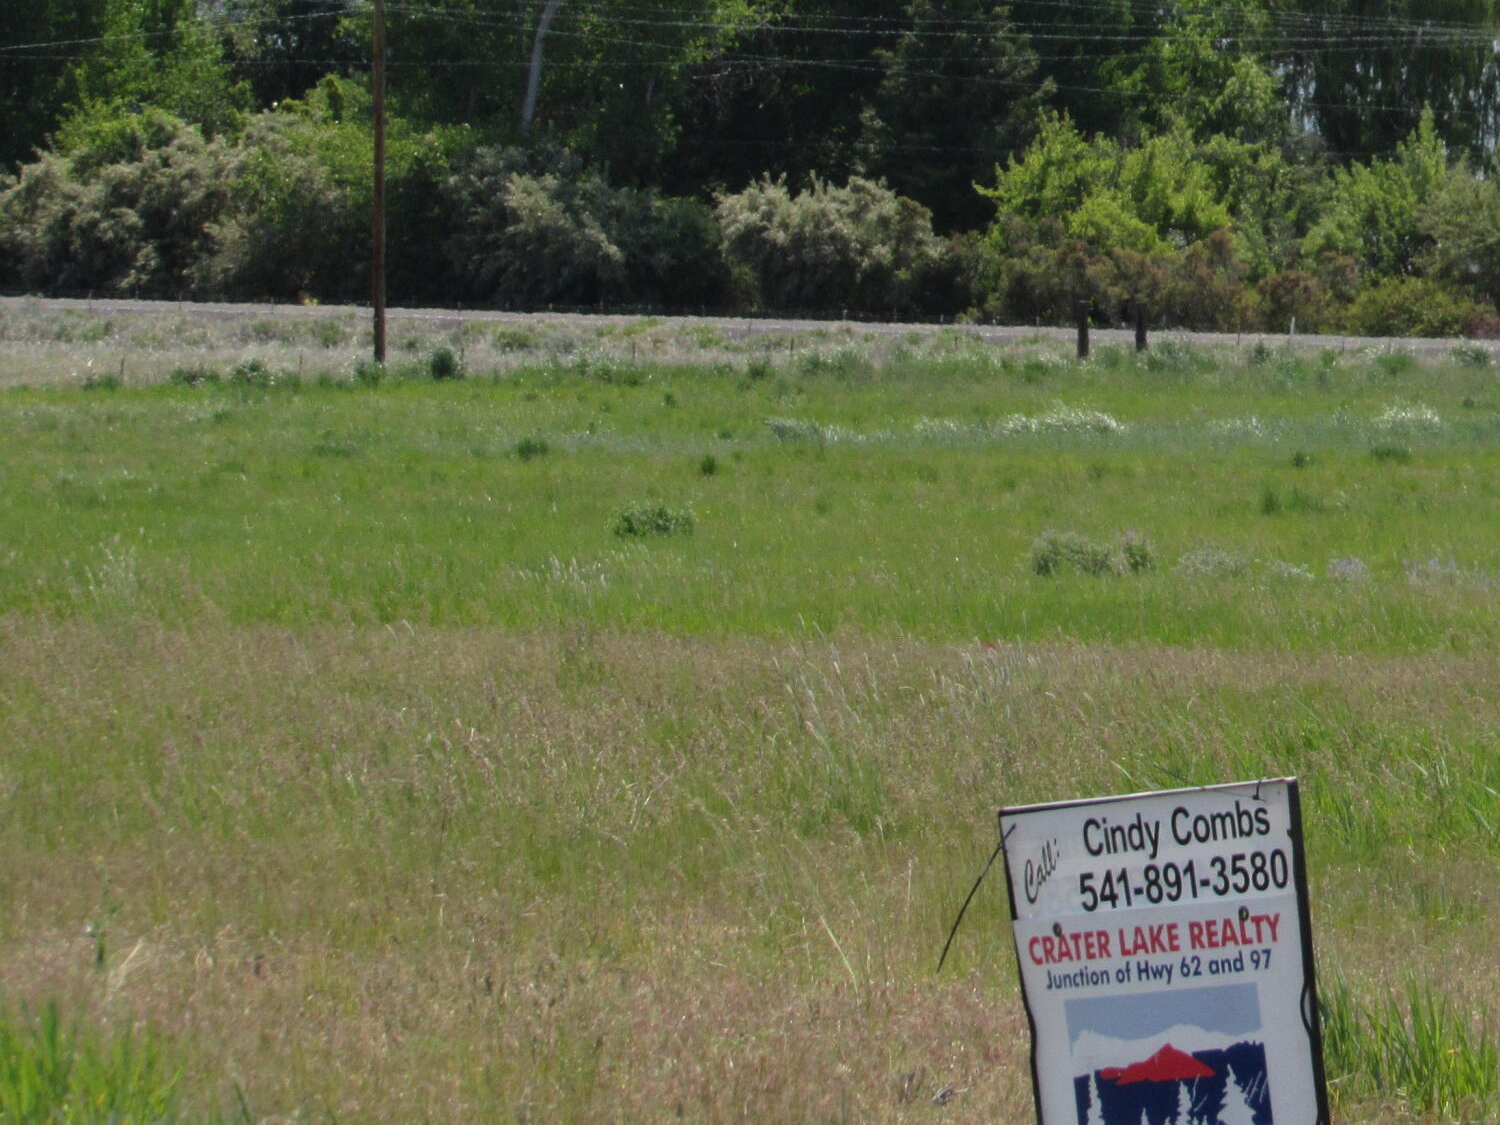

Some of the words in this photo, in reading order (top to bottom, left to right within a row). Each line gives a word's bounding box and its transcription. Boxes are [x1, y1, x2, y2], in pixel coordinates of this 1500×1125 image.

[1083, 813, 1160, 859] Cindy
[1171, 800, 1270, 846] Combs
[1080, 848, 1288, 912] 541-891-3580
[1029, 929, 1112, 965] CRATER
[1119, 923, 1181, 956] LAKE
[1190, 913, 1281, 950] REALTY
[1047, 965, 1110, 989] Junction
[1116, 960, 1132, 983] of
[1138, 961, 1173, 983] Hwy
[1181, 956, 1202, 977] 62
[1209, 950, 1244, 975] and
[1251, 949, 1272, 970] 97
